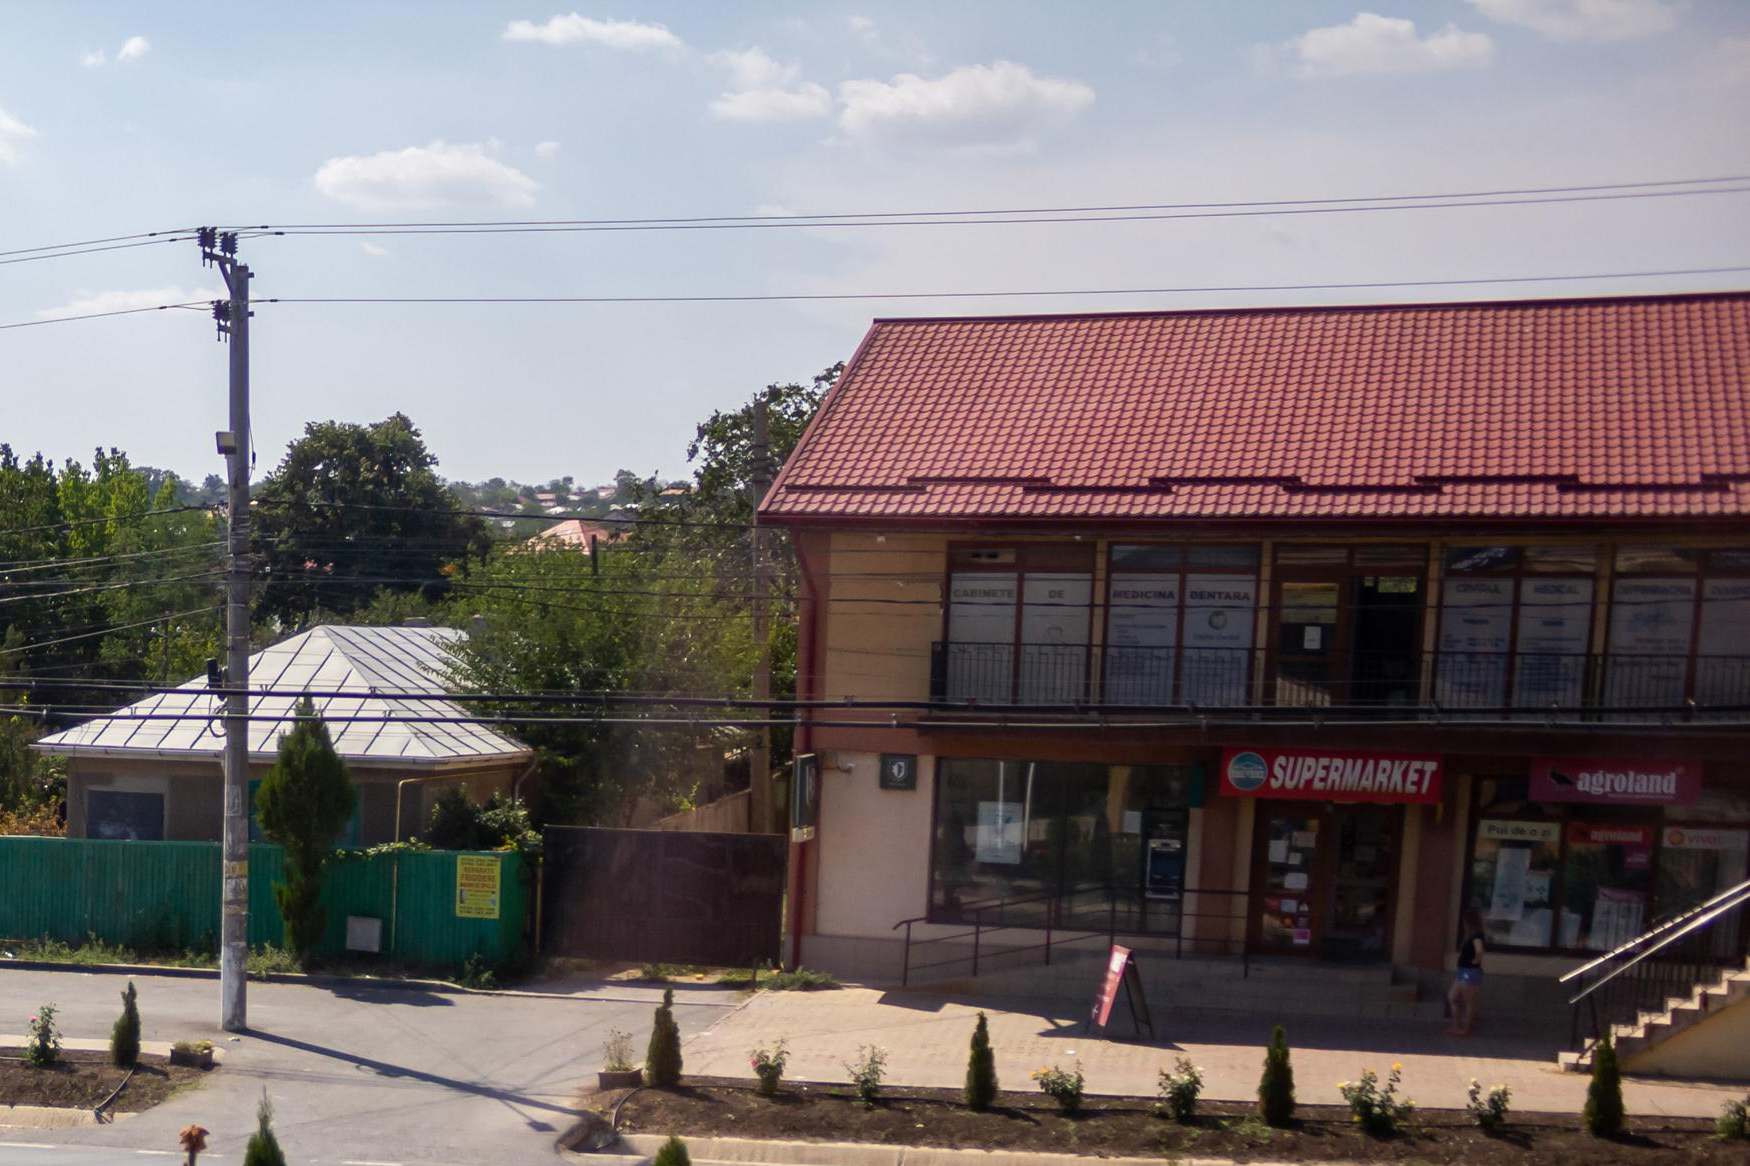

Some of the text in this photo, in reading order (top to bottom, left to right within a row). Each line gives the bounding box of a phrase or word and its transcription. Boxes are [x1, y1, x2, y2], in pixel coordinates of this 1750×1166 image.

[953, 588, 1251, 601] GABINETE DE MEDICINA DENTARA
[1269, 754, 1439, 794] SUPERMARKET
[1576, 769, 1677, 795] agroland
